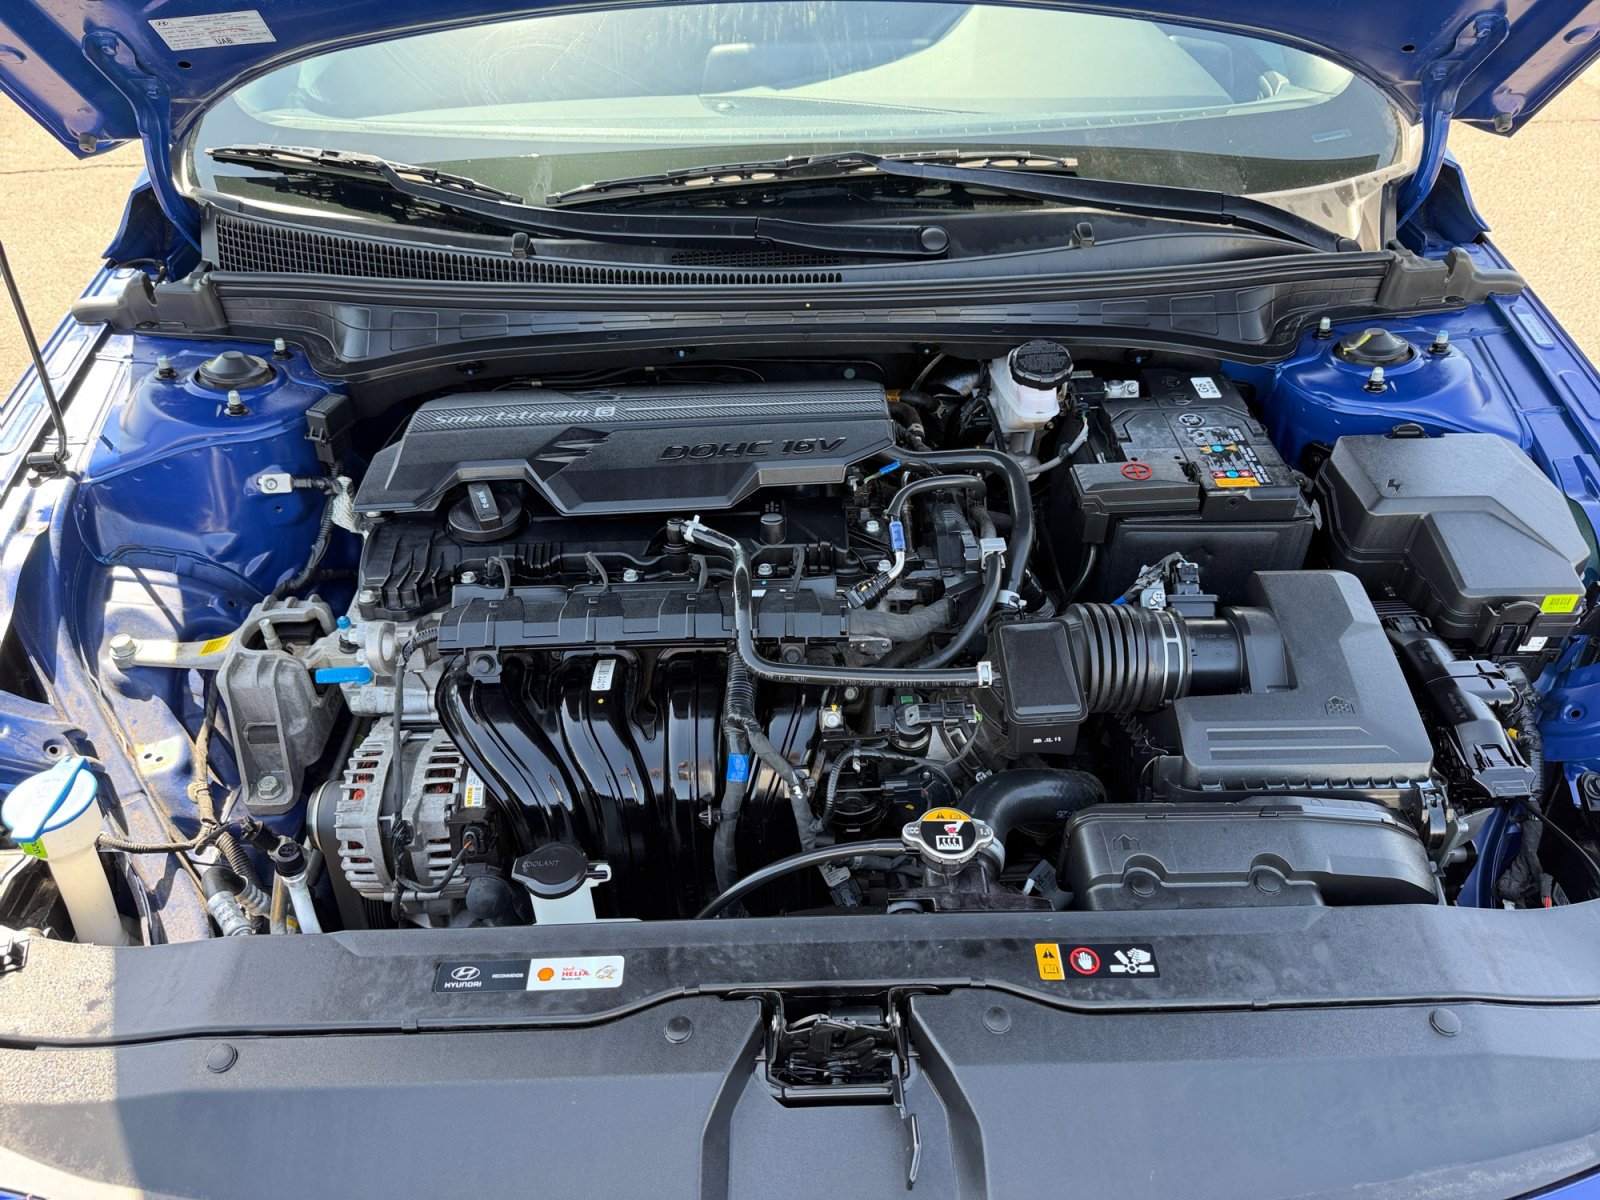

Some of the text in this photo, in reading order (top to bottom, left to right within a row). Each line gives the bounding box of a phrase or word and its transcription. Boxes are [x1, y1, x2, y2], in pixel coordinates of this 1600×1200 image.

[215, 37, 234, 45] UAB
[432, 408, 590, 425] Smartstream
[658, 436, 848, 461] DOHC 16V
[521, 859, 560, 868] COOLANT
[562, 969, 591, 977] HELIX
[444, 980, 482, 989] HYUNDAI
